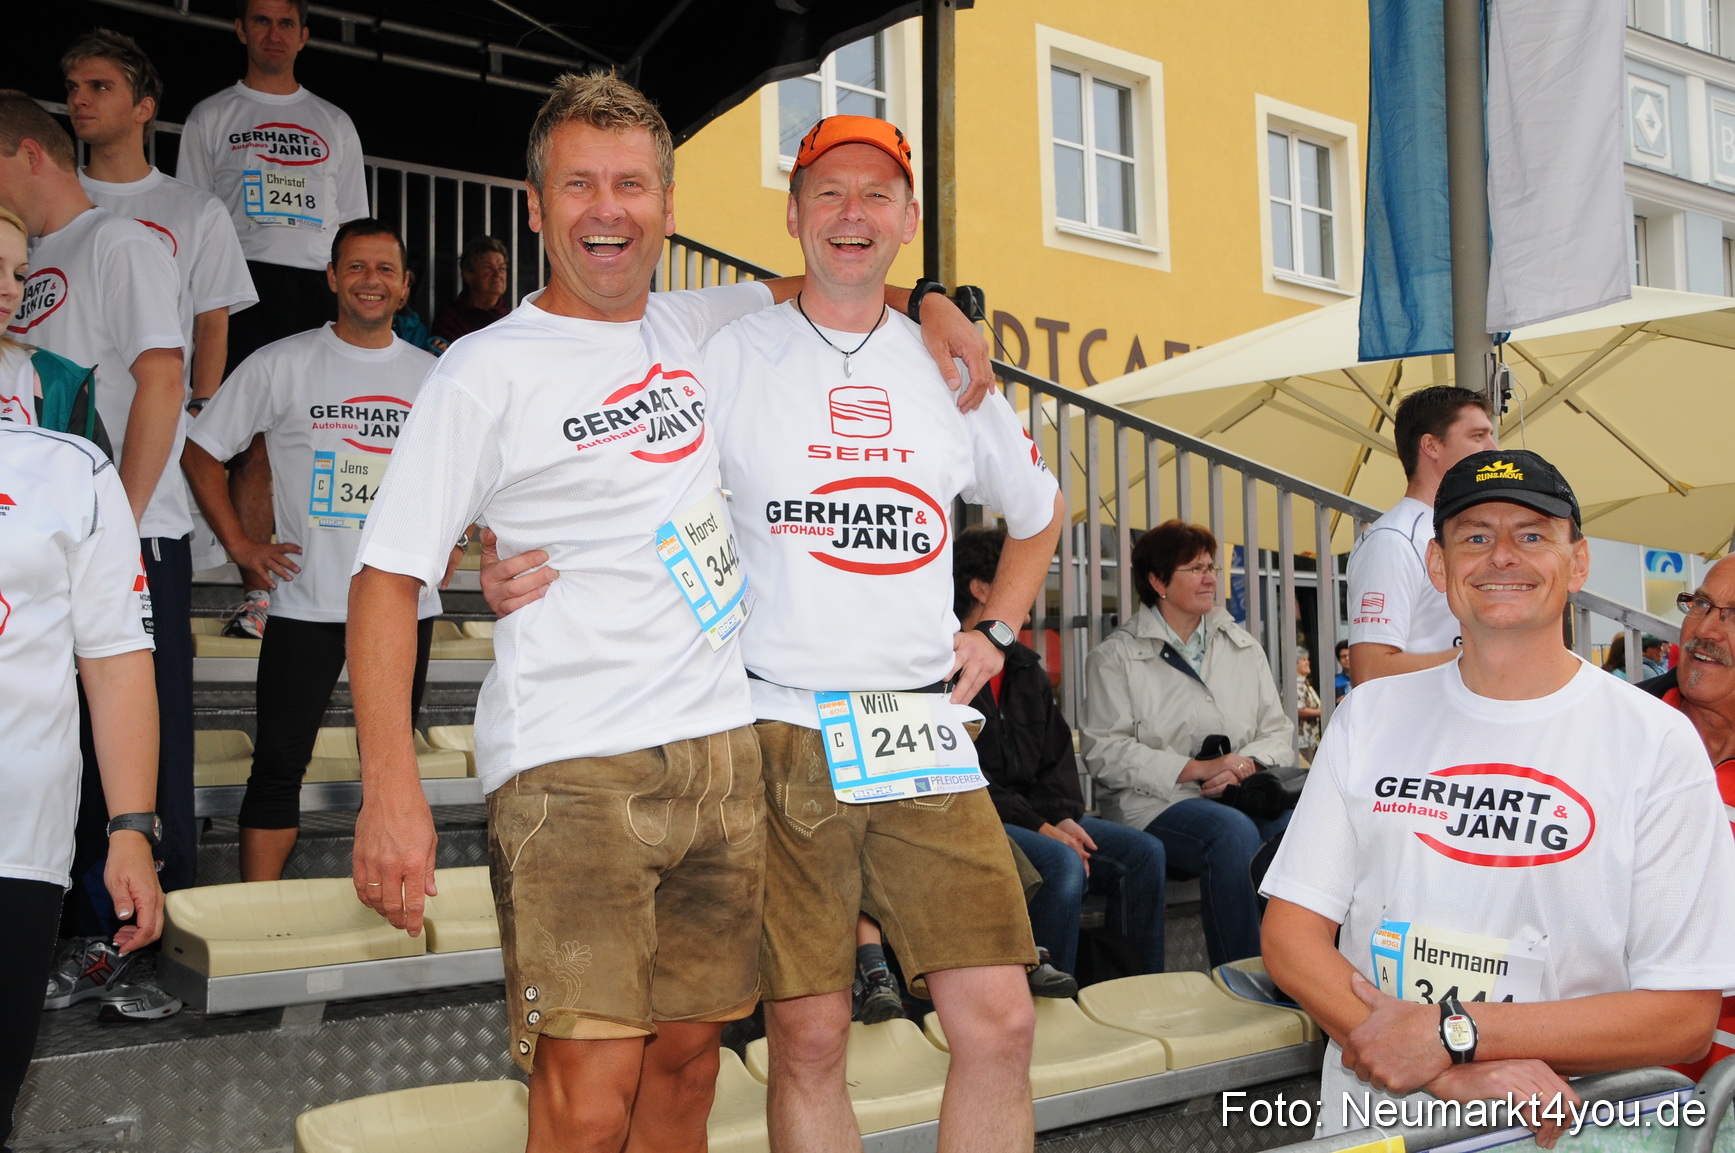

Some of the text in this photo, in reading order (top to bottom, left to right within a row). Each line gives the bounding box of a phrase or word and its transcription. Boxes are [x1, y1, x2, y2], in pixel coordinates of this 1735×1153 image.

[229, 131, 310, 145] GERHART
[268, 143, 322, 158] JÄNIG
[266, 174, 305, 188] Christof
[269, 190, 316, 209] 2418
[683, 385, 695, 397] &
[310, 405, 411, 423] GERHART
[312, 422, 359, 430] Autohaus
[576, 423, 647, 451] Autohaus
[807, 444, 915, 463] SEAT
[340, 460, 369, 475] Jens
[318, 480, 325, 490] C
[766, 500, 927, 528] GERHART &
[685, 512, 718, 546] Horst
[770, 524, 834, 536] AUTOHAUS
[832, 527, 931, 555] JÄNIG
[681, 571, 694, 588] C
[860, 693, 899, 715] Willi
[834, 723, 957, 758] C 2419
[931, 774, 983, 785] PFLEIDERER
[1374, 776, 1568, 819] GERHART &
[1372, 801, 1448, 820] Autohaus
[1445, 813, 1569, 851] JÄNIG
[1413, 936, 1508, 976] Hermann
[1382, 966, 1389, 984] A
